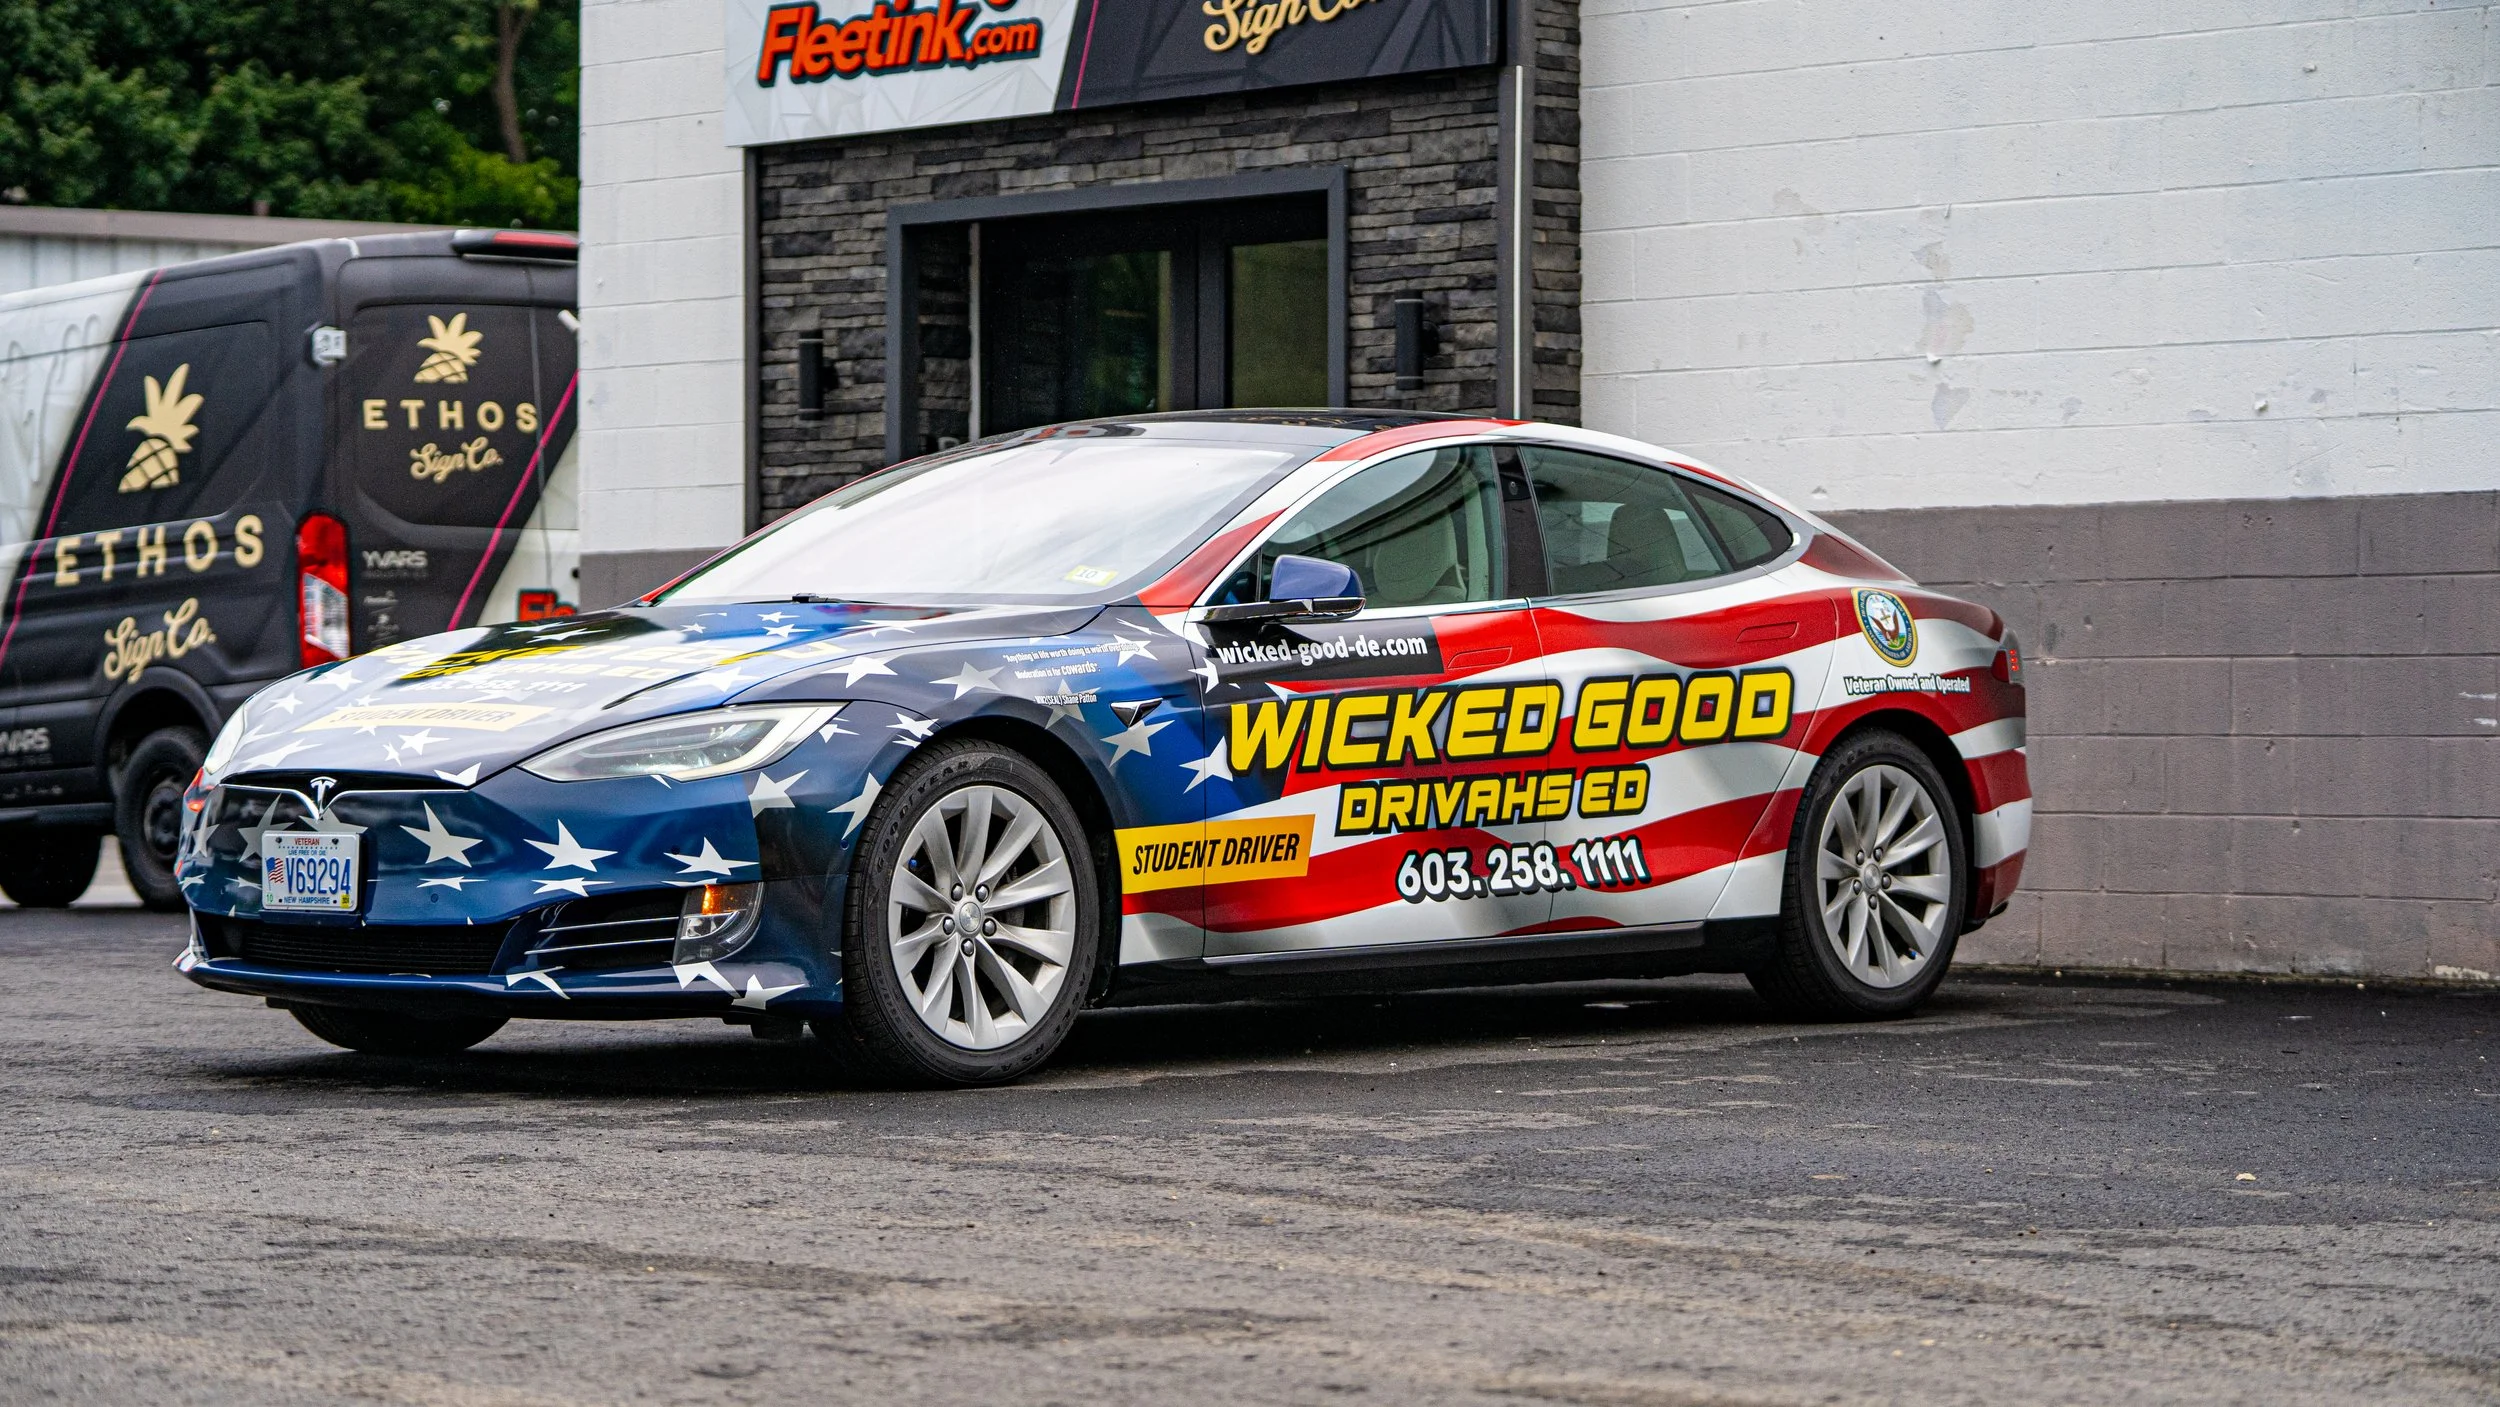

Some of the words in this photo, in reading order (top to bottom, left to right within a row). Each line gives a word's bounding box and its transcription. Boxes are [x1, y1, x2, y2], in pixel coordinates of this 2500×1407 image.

[758, 0, 1038, 81] Fleetink.com
[363, 399, 538, 432] ETHOS
[410, 442, 465, 484] Sign
[461, 436, 504, 472] Co.
[55, 515, 264, 587] ETHOS
[104, 616, 165, 684] Sign
[163, 597, 217, 659] Co.
[1216, 635, 1428, 666] wicked-good-de.com
[1079, 692, 1097, 703] Patton
[1845, 676, 1887, 694] Veteran
[1888, 674, 1919, 692] Owned
[1920, 674, 1935, 691] and
[1936, 676, 1970, 694] Operated
[1229, 684, 1561, 770] WICKED
[1576, 673, 1792, 748] GOOD
[1341, 777, 1574, 831] DRIVAHS
[1580, 768, 1649, 815] ED
[285, 857, 351, 894] V69294
[1133, 838, 1221, 875] STUDENT
[1221, 833, 1300, 866] DRIVER
